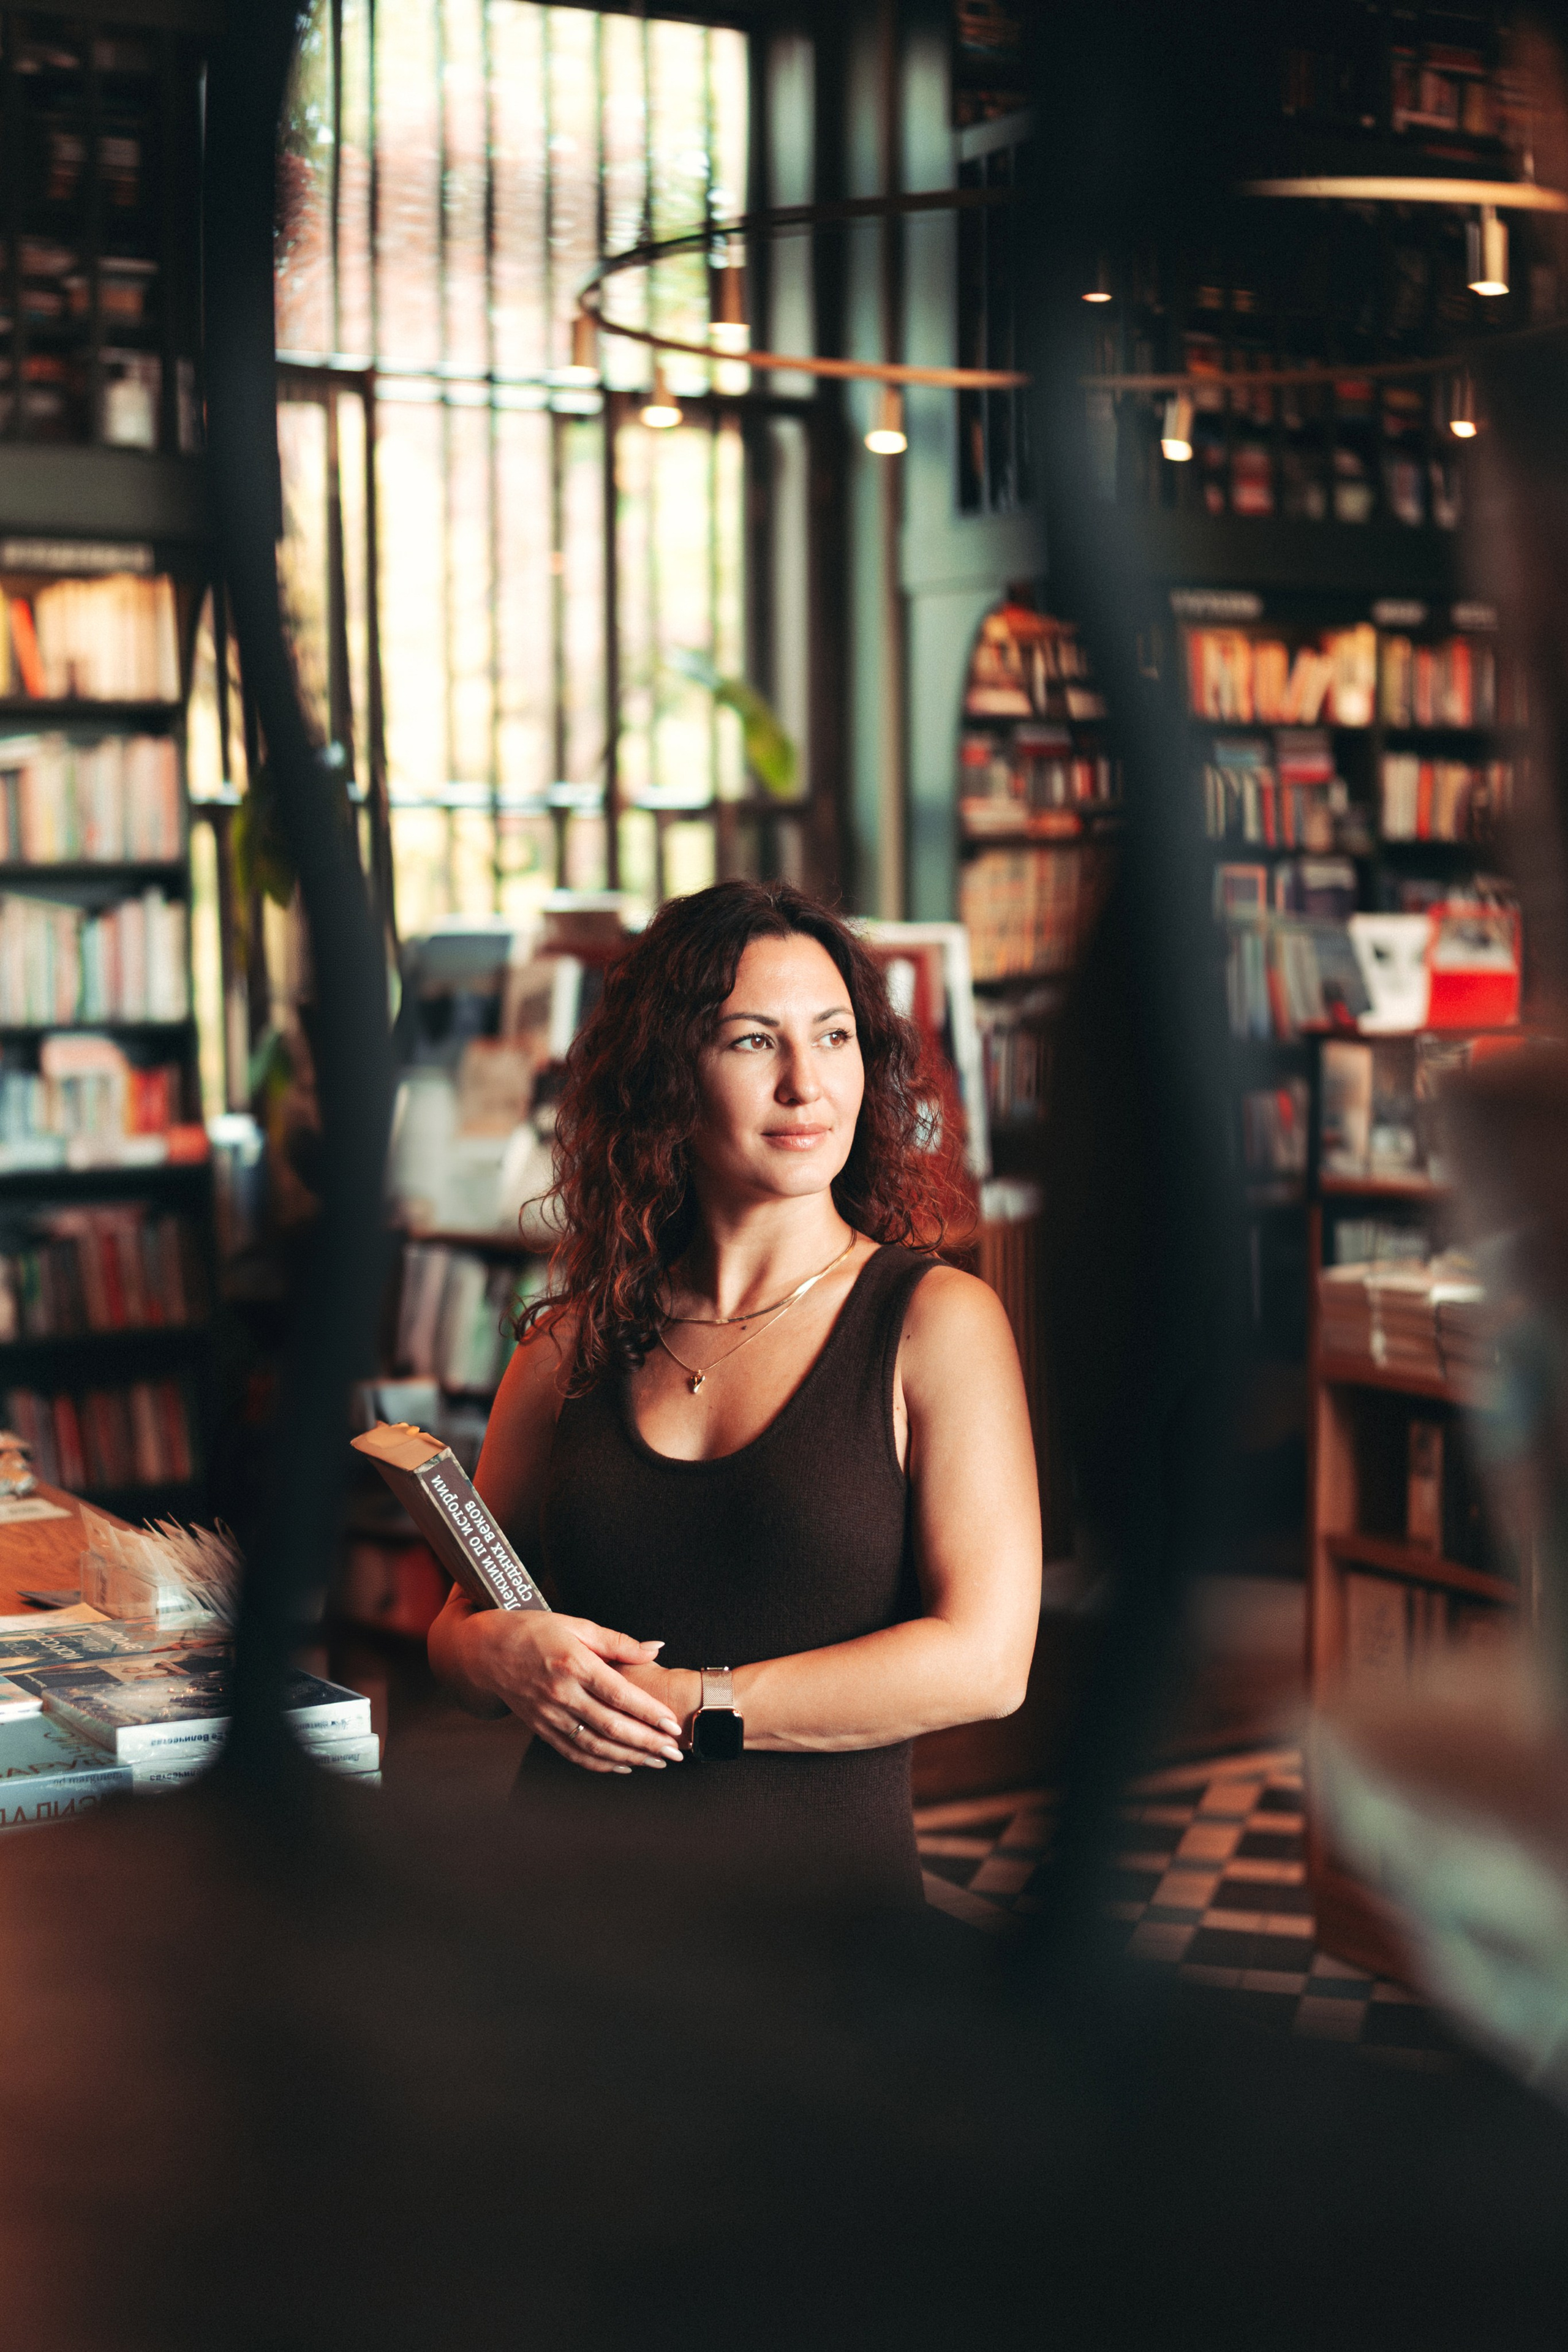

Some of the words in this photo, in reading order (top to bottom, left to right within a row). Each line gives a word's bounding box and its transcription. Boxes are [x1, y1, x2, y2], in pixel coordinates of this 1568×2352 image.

[431, 1474, 474, 1536] истории
[464, 1501, 495, 1542] веков
[469, 1536, 488, 1557] по
[481, 1555, 521, 1611] Лекции
[491, 1542, 533, 1602] средних
[149, 1733, 209, 1747] Величества
